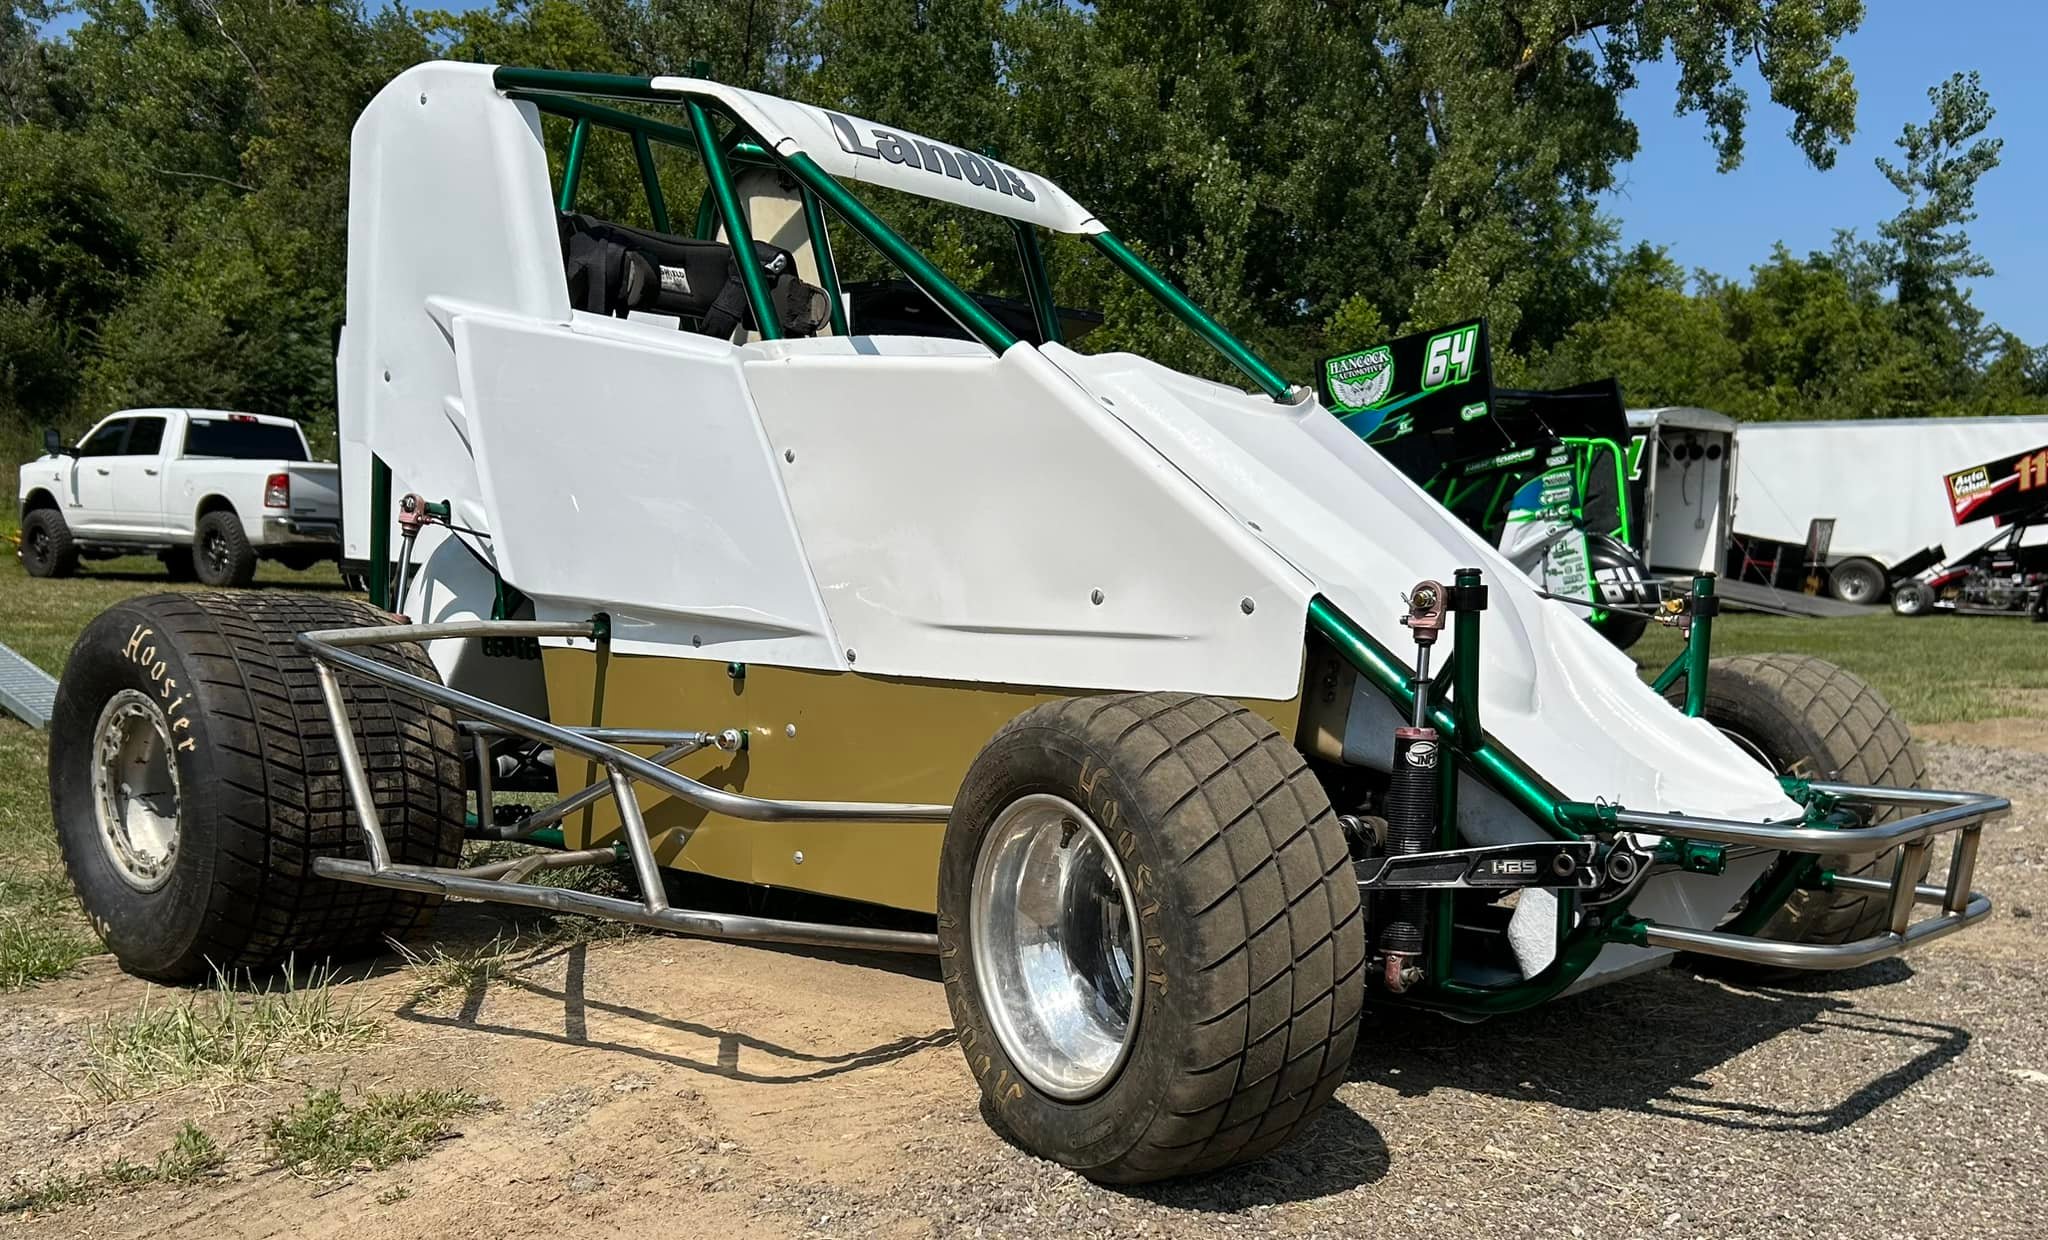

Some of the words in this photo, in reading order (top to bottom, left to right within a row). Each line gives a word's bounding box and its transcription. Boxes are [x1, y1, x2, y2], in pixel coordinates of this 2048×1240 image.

[824, 111, 1036, 203] Landis
[1329, 350, 1390, 375] HANCOCK
[1426, 330, 1475, 387] 64
[1955, 471, 1985, 488] Auto
[1956, 480, 1989, 496] Value
[2014, 450, 2048, 492] 11
[121, 623, 196, 751] Hoosier
[1075, 754, 1169, 997] Hoosier
[1491, 859, 1538, 875] HBS
